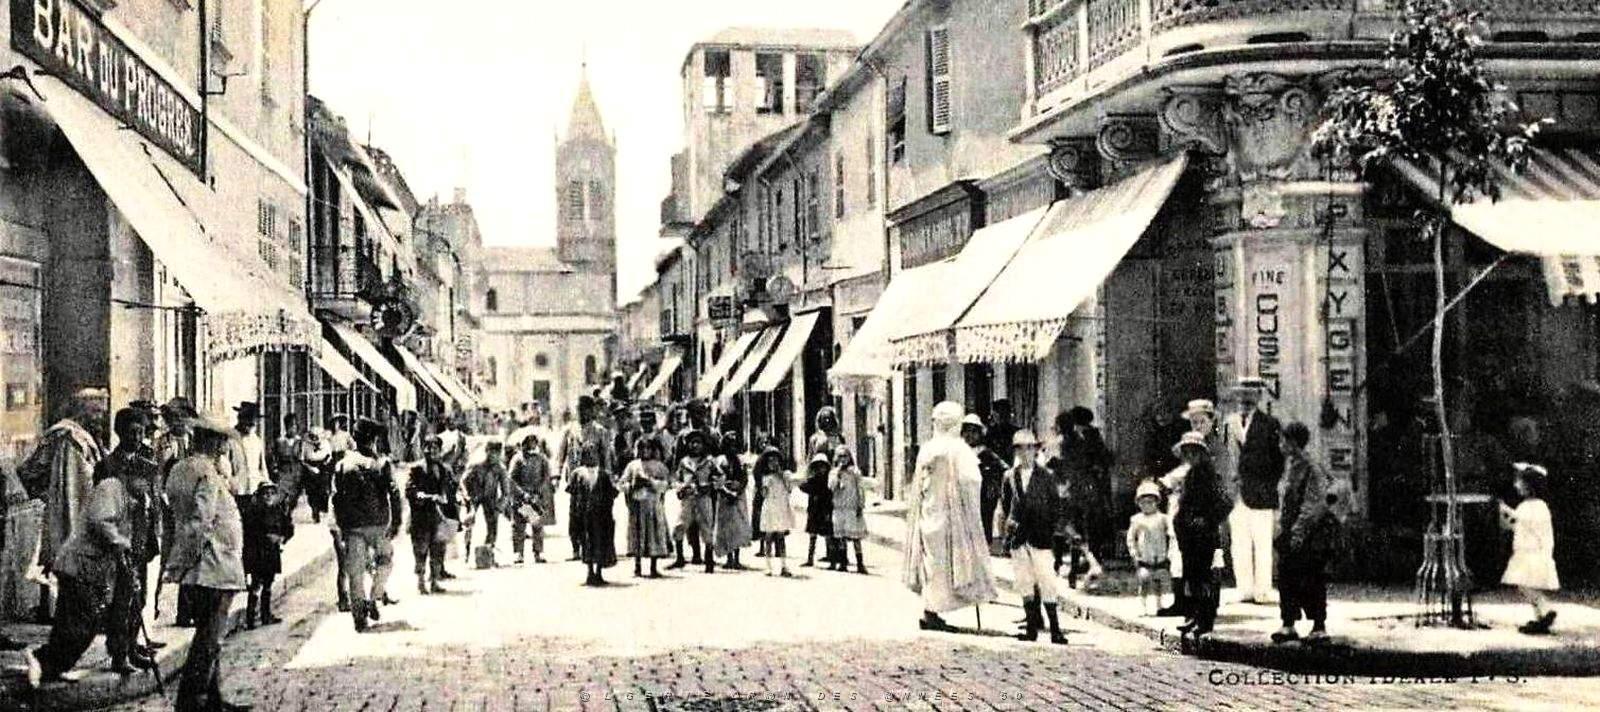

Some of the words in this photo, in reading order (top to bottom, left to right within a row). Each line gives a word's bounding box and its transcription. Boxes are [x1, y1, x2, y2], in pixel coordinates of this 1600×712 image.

[33, 0, 94, 81] BAR
[99, 40, 119, 100] DU
[124, 53, 195, 156] PROGRES
